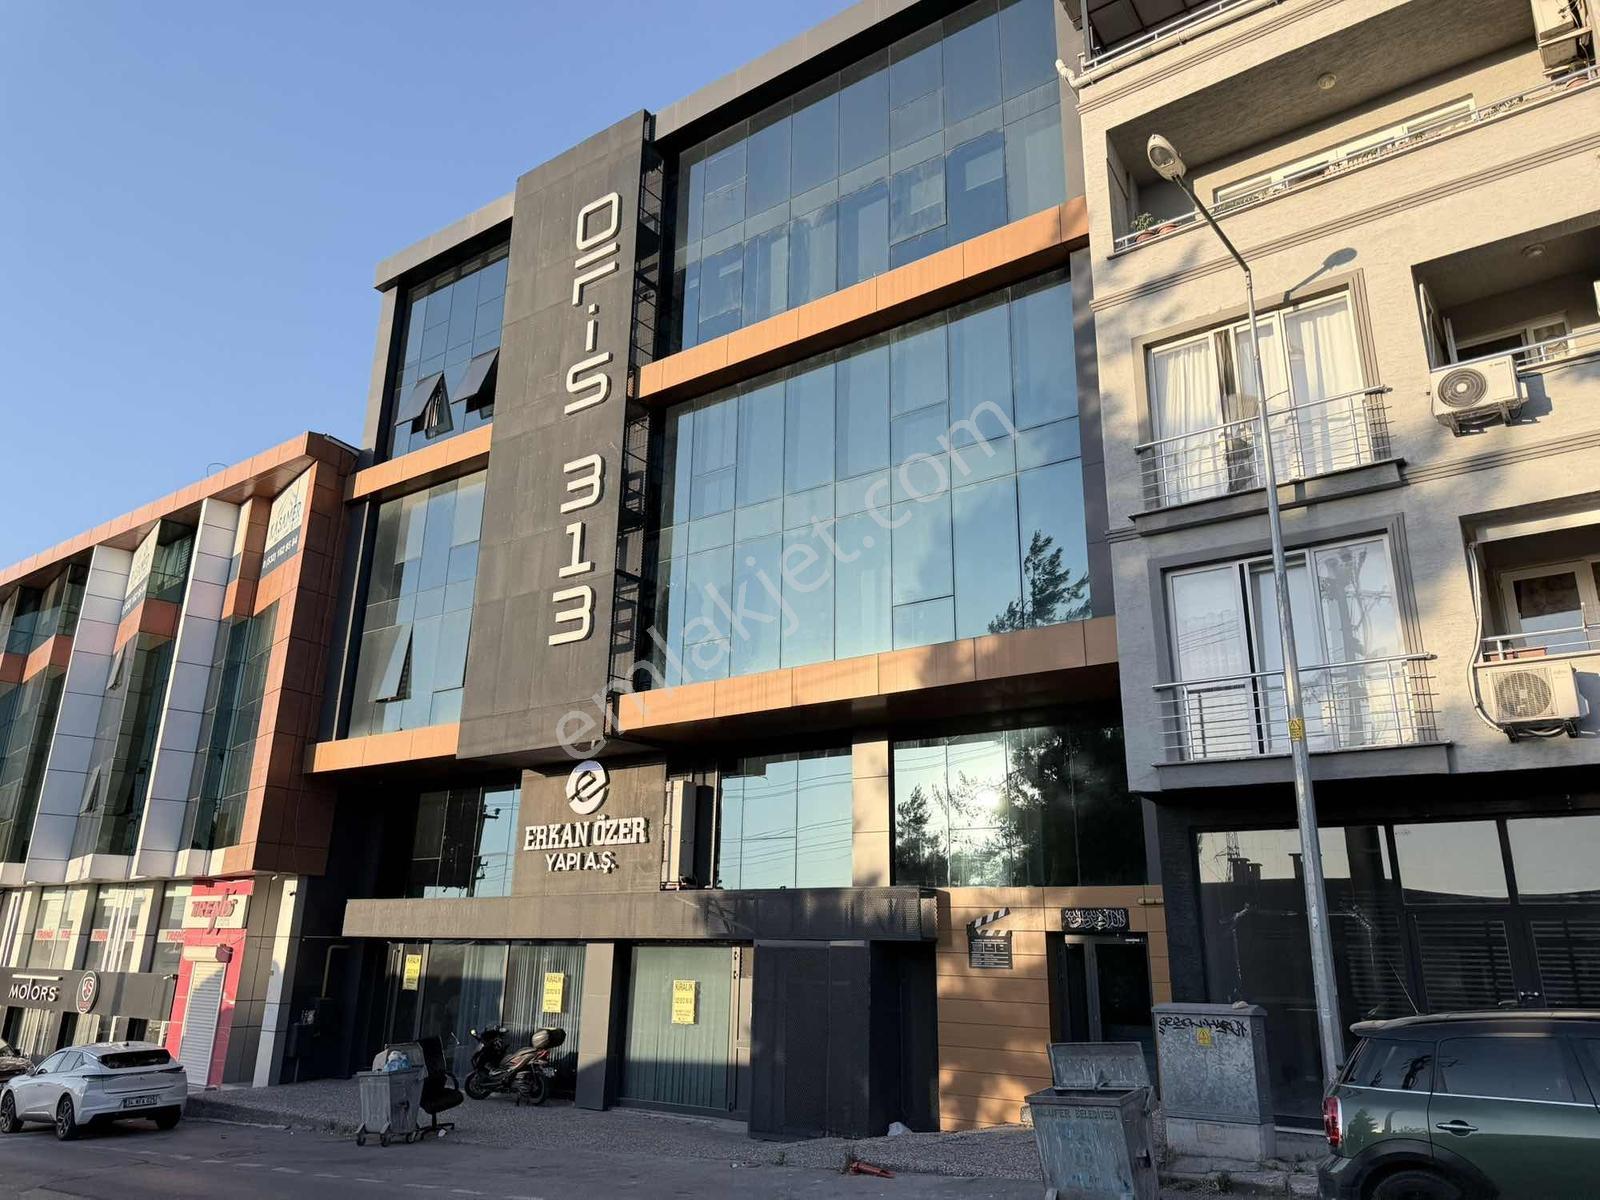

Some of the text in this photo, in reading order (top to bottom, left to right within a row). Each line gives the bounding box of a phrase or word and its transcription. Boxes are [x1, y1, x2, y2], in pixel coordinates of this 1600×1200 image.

[548, 453, 604, 647] 313
[523, 814, 646, 851] ERKAN ÖZER
[545, 852, 581, 872] YAPI
[8, 974, 59, 1002] MOTORS
